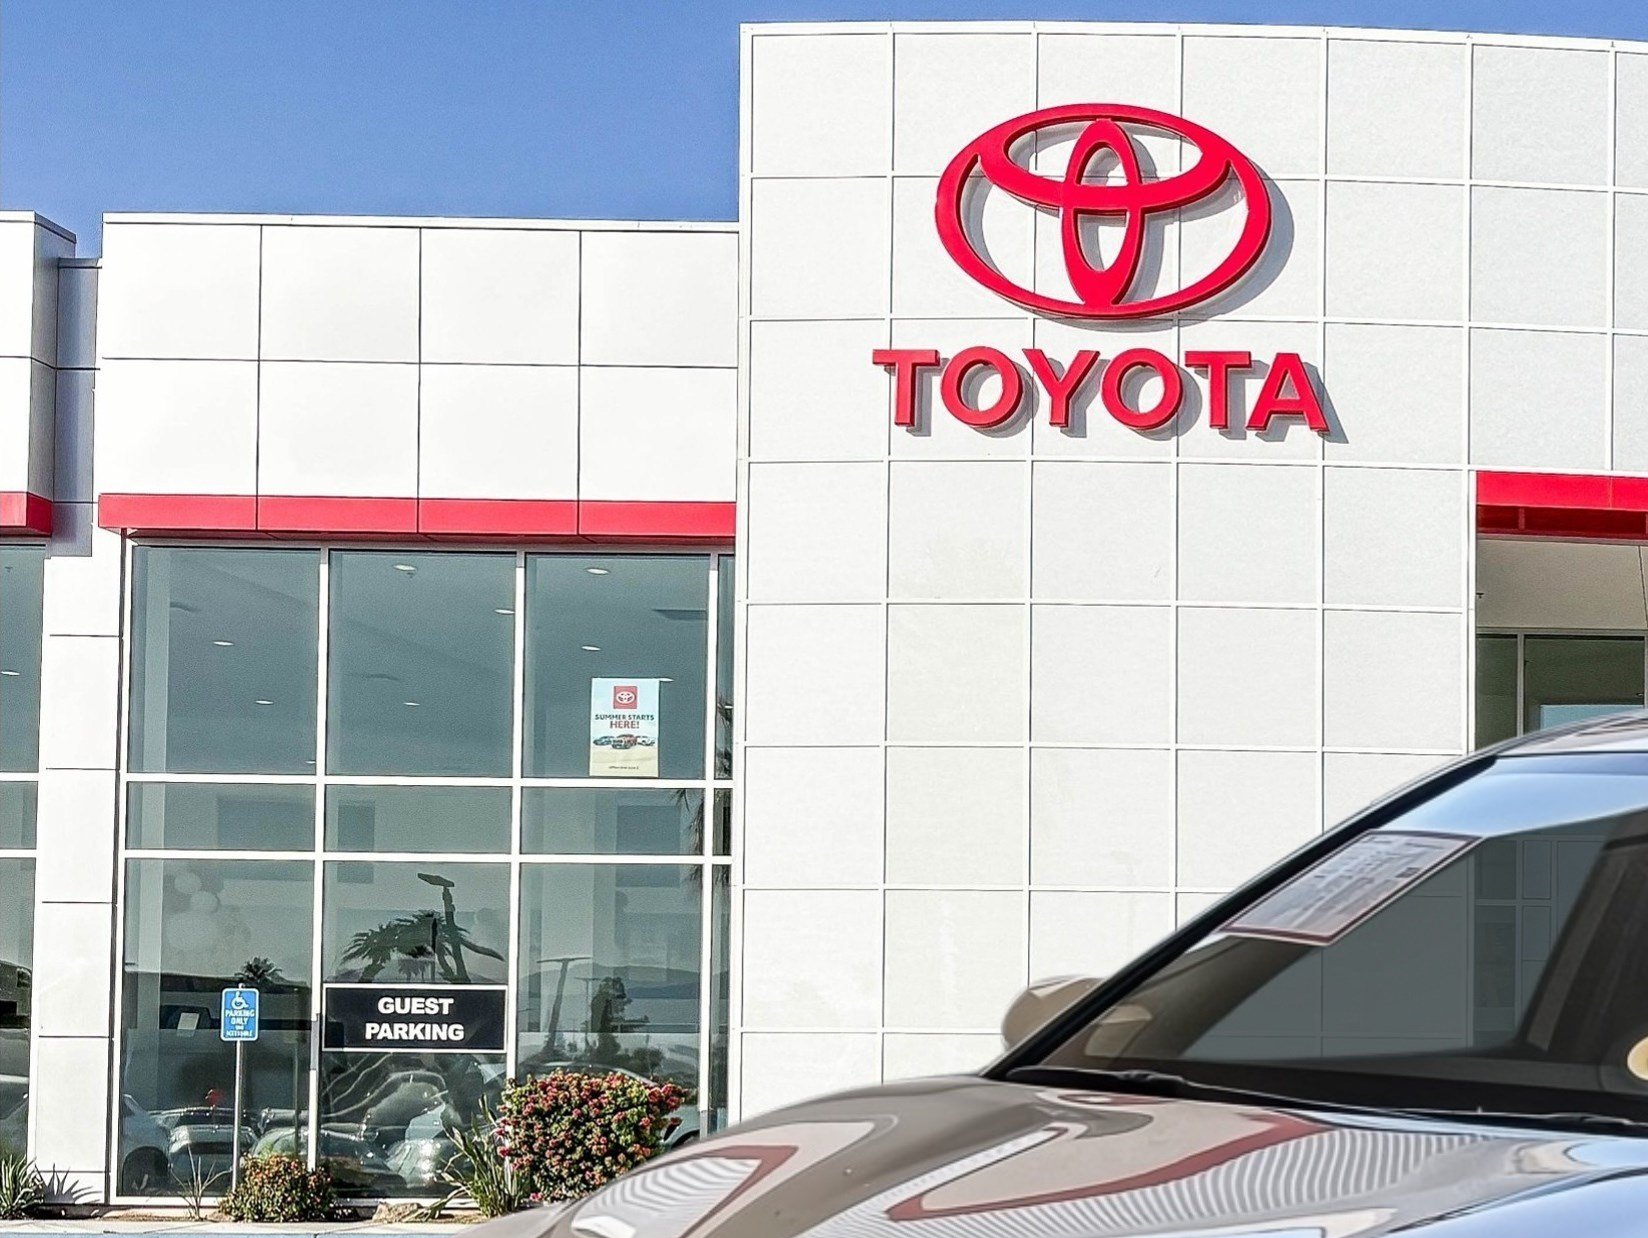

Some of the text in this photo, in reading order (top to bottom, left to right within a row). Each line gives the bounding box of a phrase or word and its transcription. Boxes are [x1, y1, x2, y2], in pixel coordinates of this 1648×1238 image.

[872, 346, 1330, 432] TOYOTA
[610, 720, 639, 728] HERE!
[377, 997, 454, 1015] GUEST
[225, 1009, 255, 1017] PARKING
[230, 1017, 249, 1025] ONLY
[365, 1022, 465, 1041] PARKING
